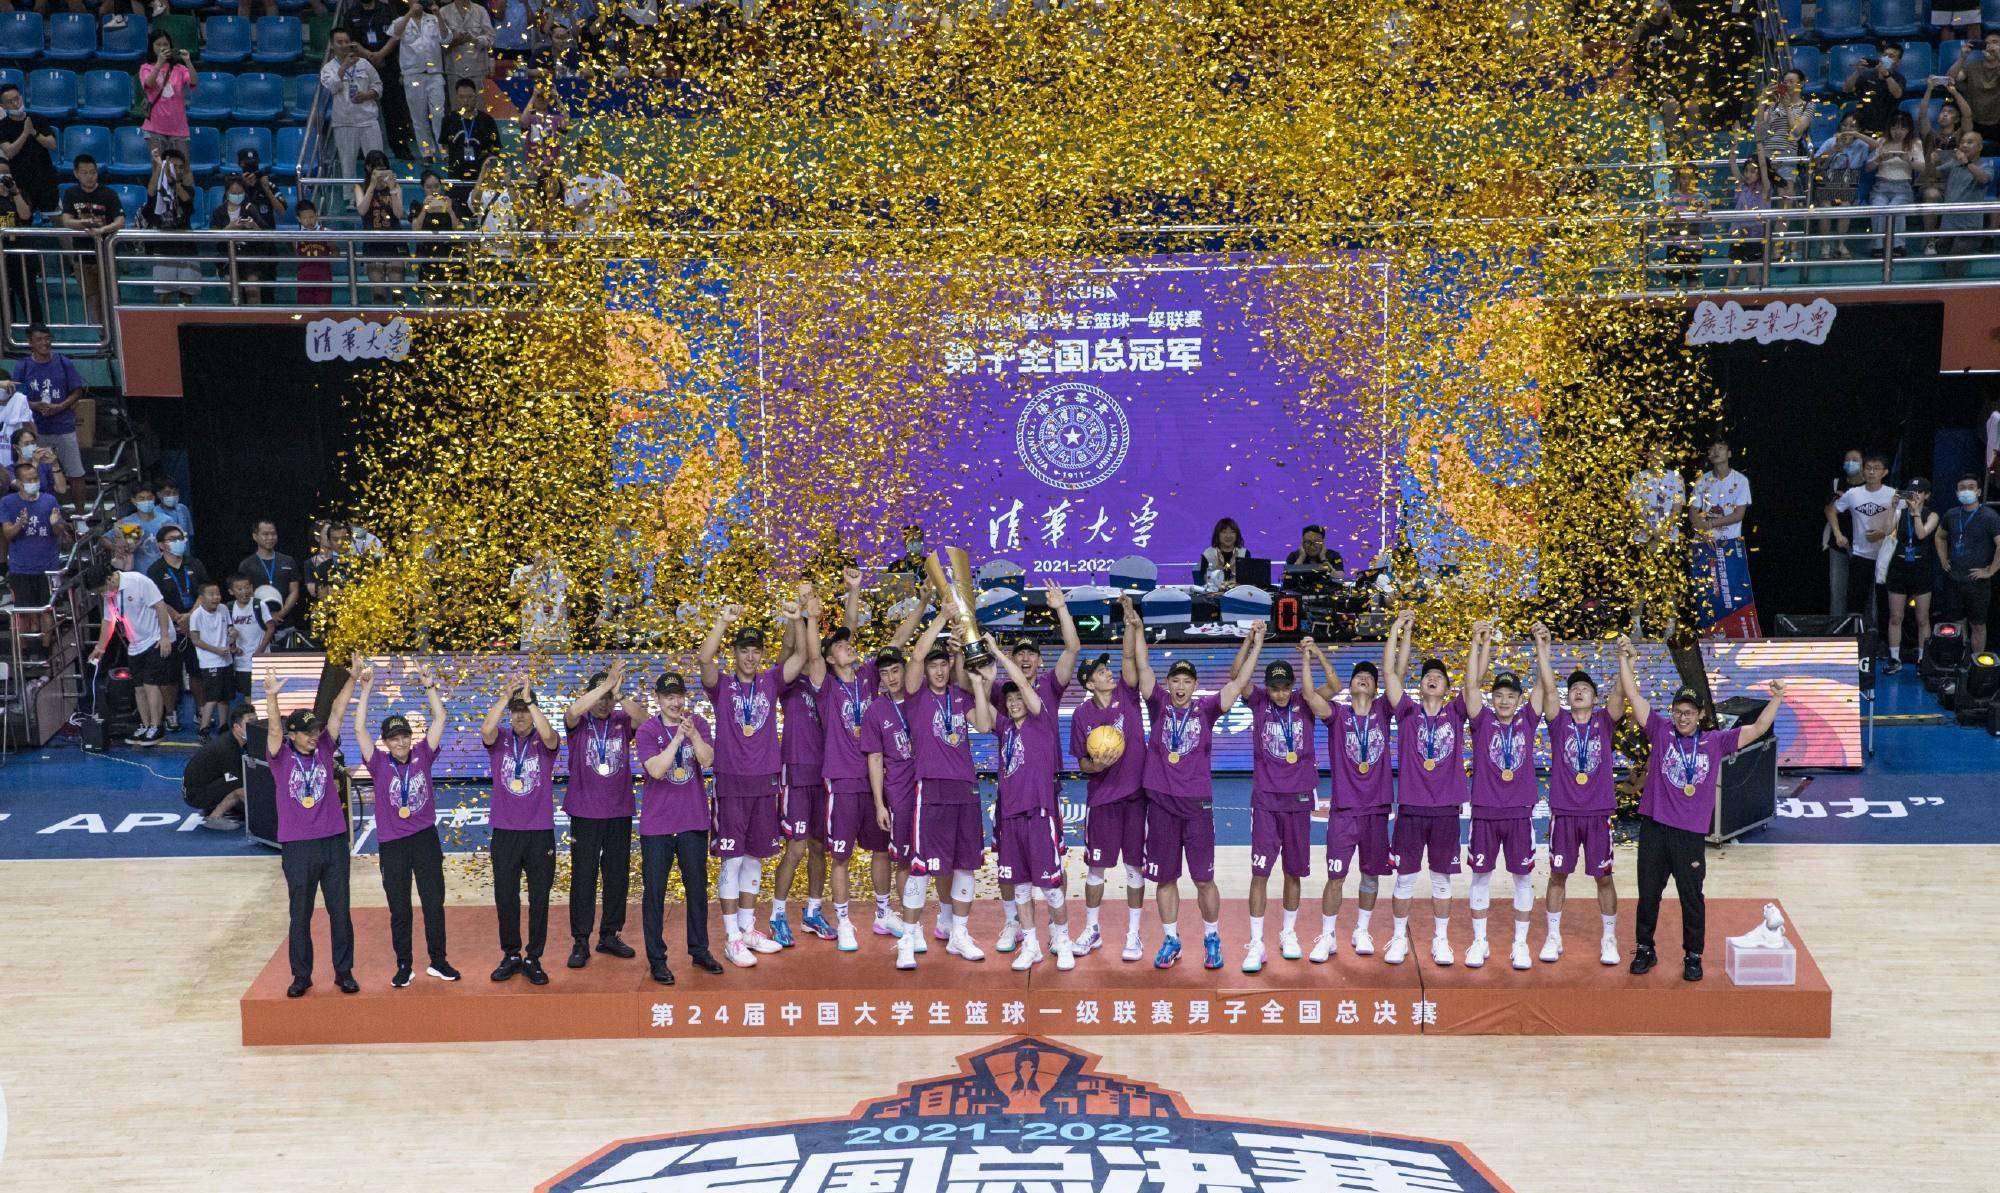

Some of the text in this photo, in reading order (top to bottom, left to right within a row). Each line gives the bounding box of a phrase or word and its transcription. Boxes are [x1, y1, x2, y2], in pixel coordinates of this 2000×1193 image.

[1278, 598, 1297, 630] 0
[795, 821, 807, 834] 15
[720, 838, 736, 851] 32
[833, 840, 847, 853] 12
[1093, 848, 1101, 861] 5
[1253, 854, 1267, 869] 24
[1476, 853, 1485, 867] 2
[1554, 855, 1564, 868] 6
[927, 858, 941, 871] 18
[1148, 862, 1159, 876] 11
[1328, 858, 1343, 873] 20
[999, 865, 1012, 879] 25
[844, 1121, 1171, 1145] 2021-2022
